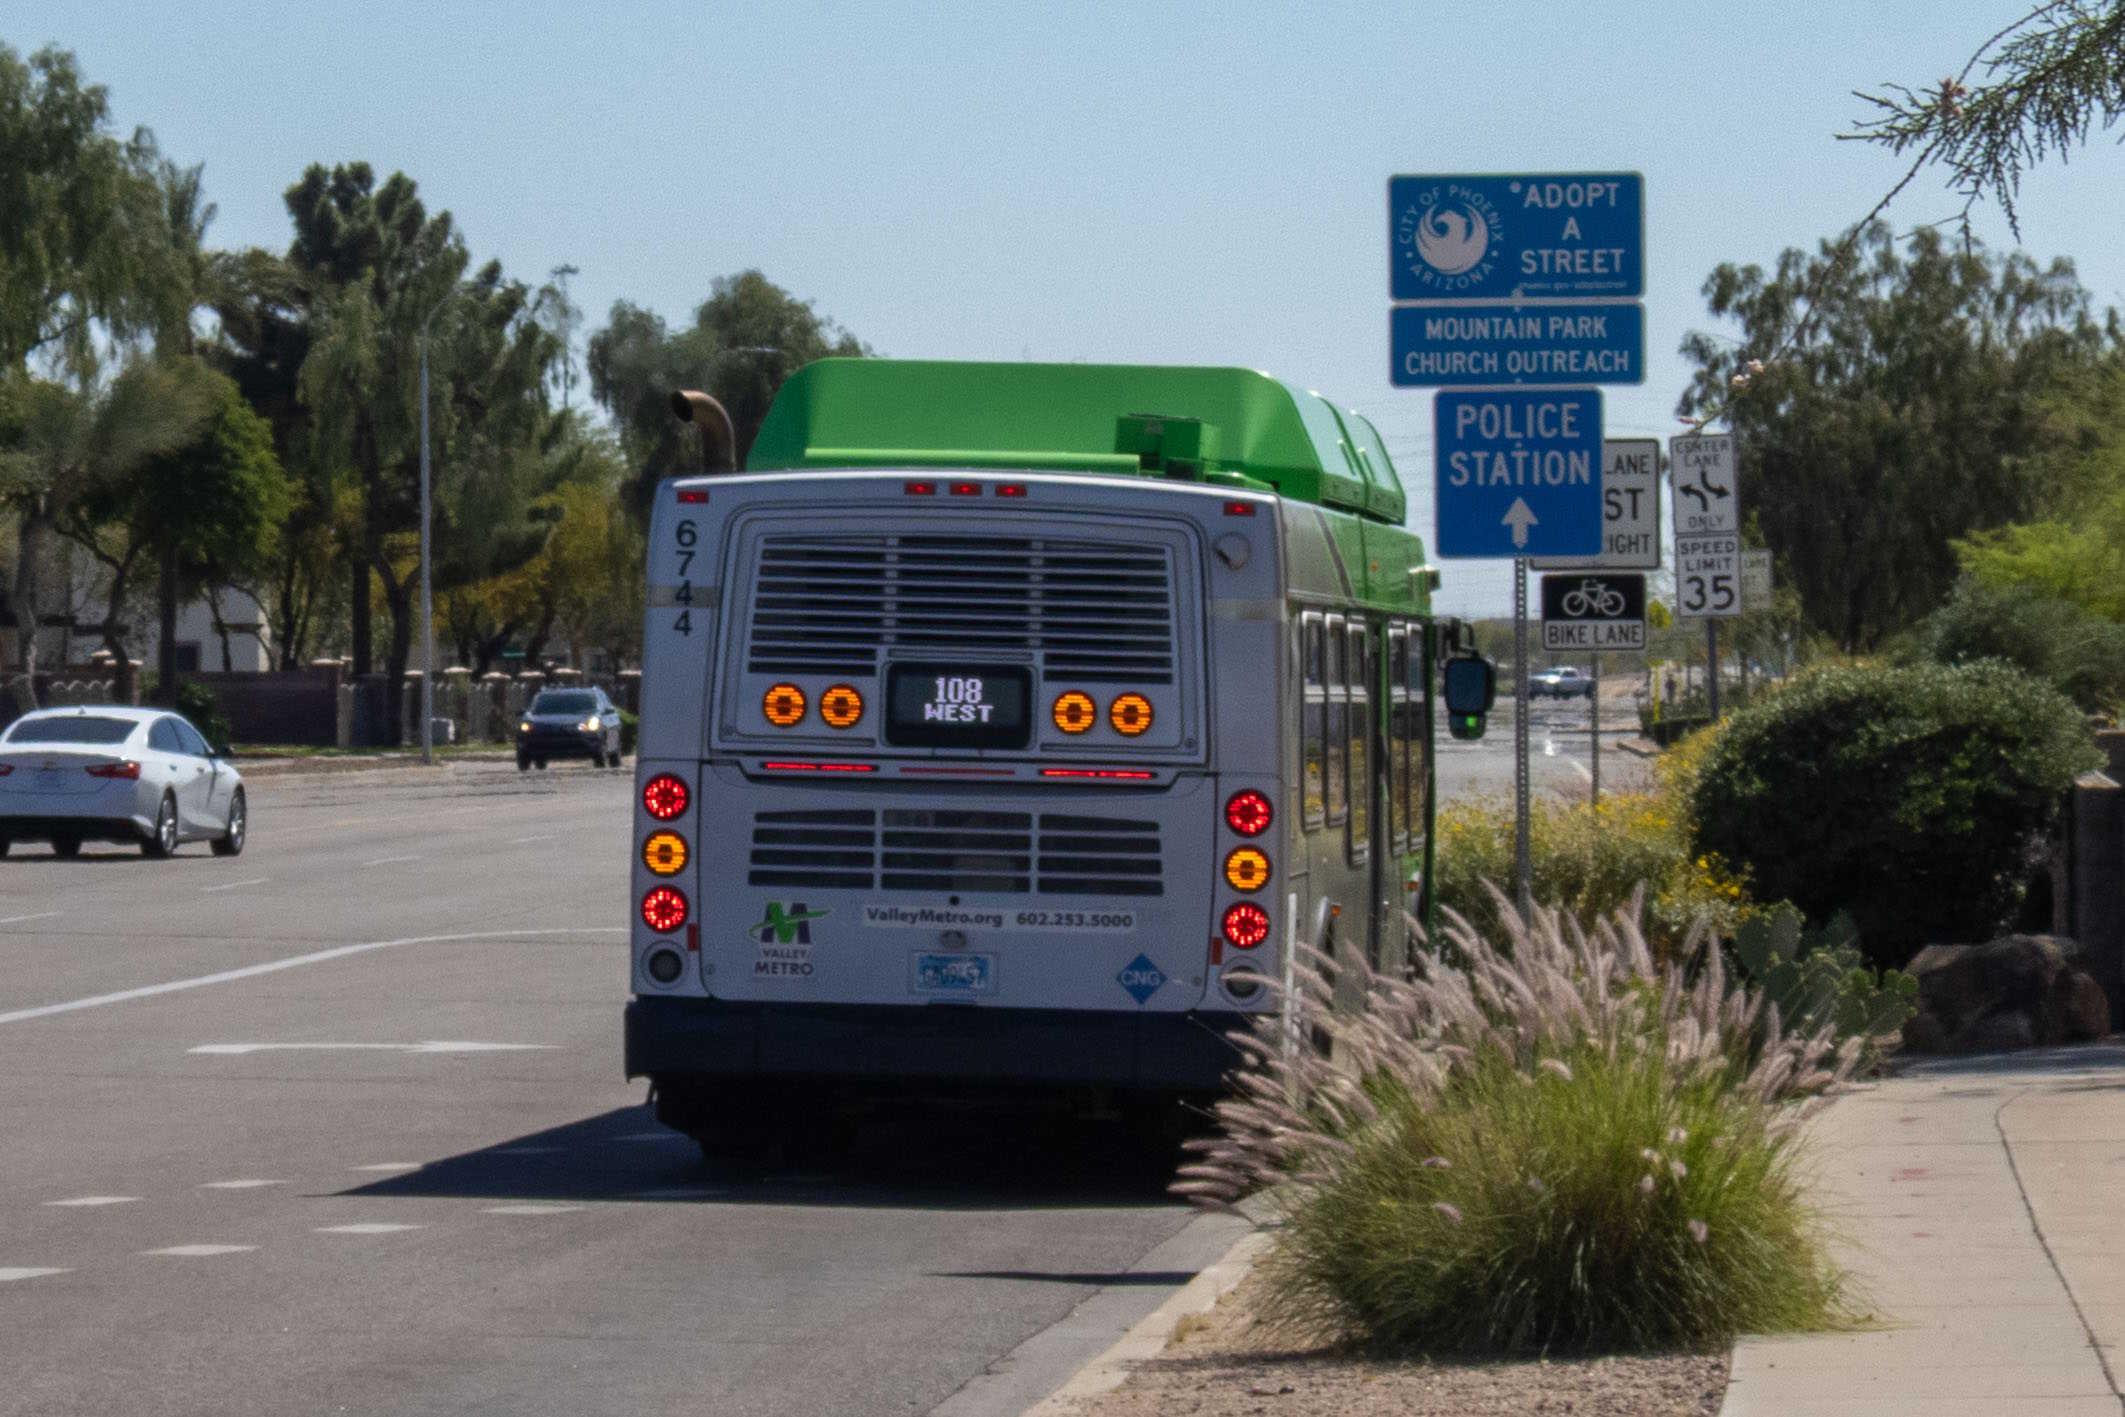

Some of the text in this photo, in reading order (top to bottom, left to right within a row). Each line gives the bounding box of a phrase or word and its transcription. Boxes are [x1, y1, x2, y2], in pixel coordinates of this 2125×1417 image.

[1523, 182, 1621, 208] ADOPT
[1400, 184, 1504, 244] CITY OF PHOENIX
[1562, 217, 1582, 240] A
[1521, 249, 1625, 274] STREET
[1410, 262, 1494, 290] ARIZONA
[1425, 316, 1608, 340] MOUNTAIN PARK
[1405, 350, 1629, 374] CHURCH OUTREACH
[1456, 403, 1581, 440] POLICE
[1450, 451, 1591, 486] STATION
[1684, 454, 1721, 468] LANE
[1604, 488, 1645, 521] ST
[1688, 515, 1724, 529] ONLY
[1605, 533, 1650, 554] IGHT
[1680, 542, 1736, 556] SPEED
[1685, 558, 1732, 572] LIMIT
[1685, 575, 1735, 611] 35
[1549, 624, 1641, 644] BIKE LANE
[935, 677, 983, 703] 108
[924, 703, 994, 723] WEST
[867, 908, 1133, 927] ValleyMetro.org 602.253.5000
[762, 949, 808, 959] VALLEY
[755, 961, 814, 976] METRO
[1122, 970, 1161, 986] CNG
